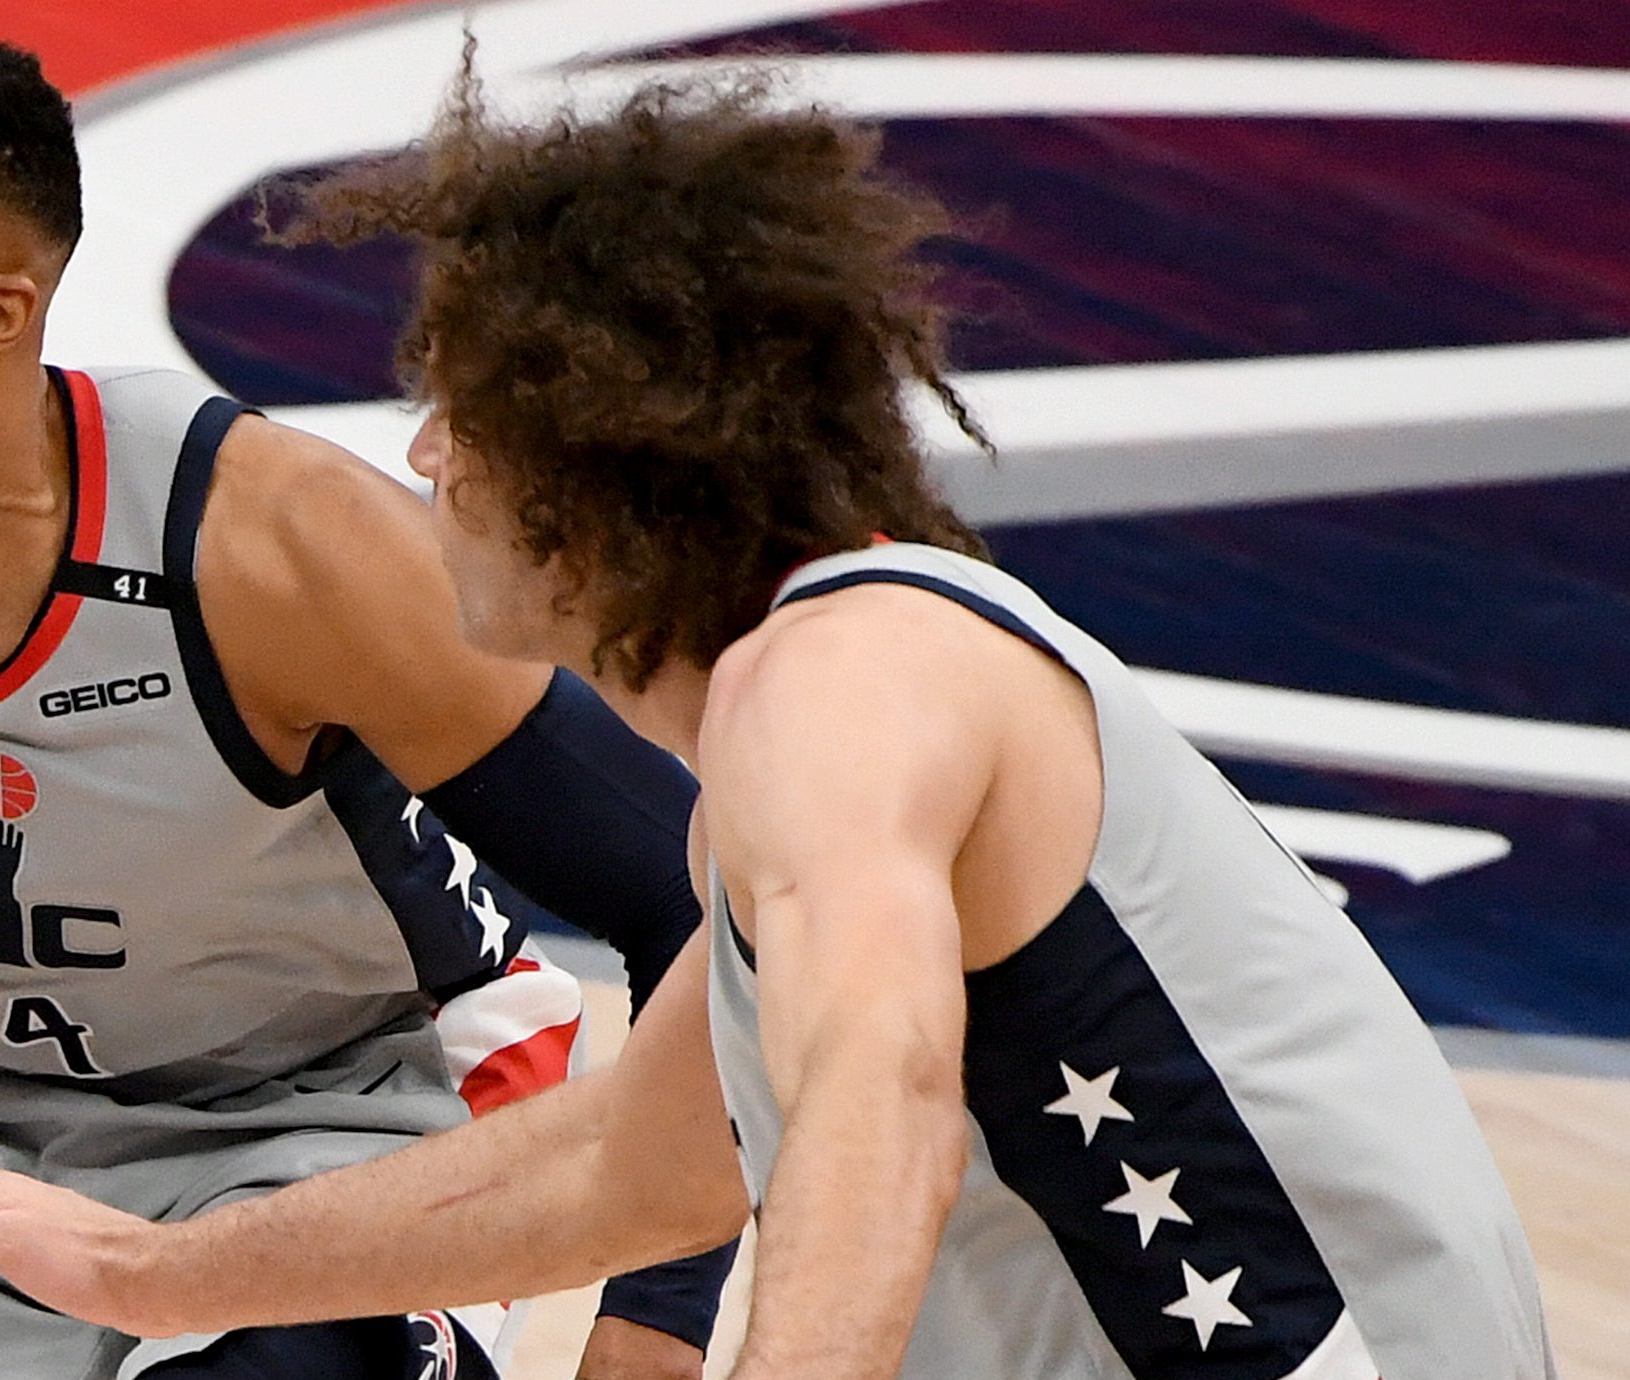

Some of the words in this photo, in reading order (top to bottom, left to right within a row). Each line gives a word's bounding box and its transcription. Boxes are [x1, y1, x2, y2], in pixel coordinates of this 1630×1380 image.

[114, 574, 147, 600] 41
[39, 672, 171, 718] GEICO
[3, 995, 115, 1078] 4
